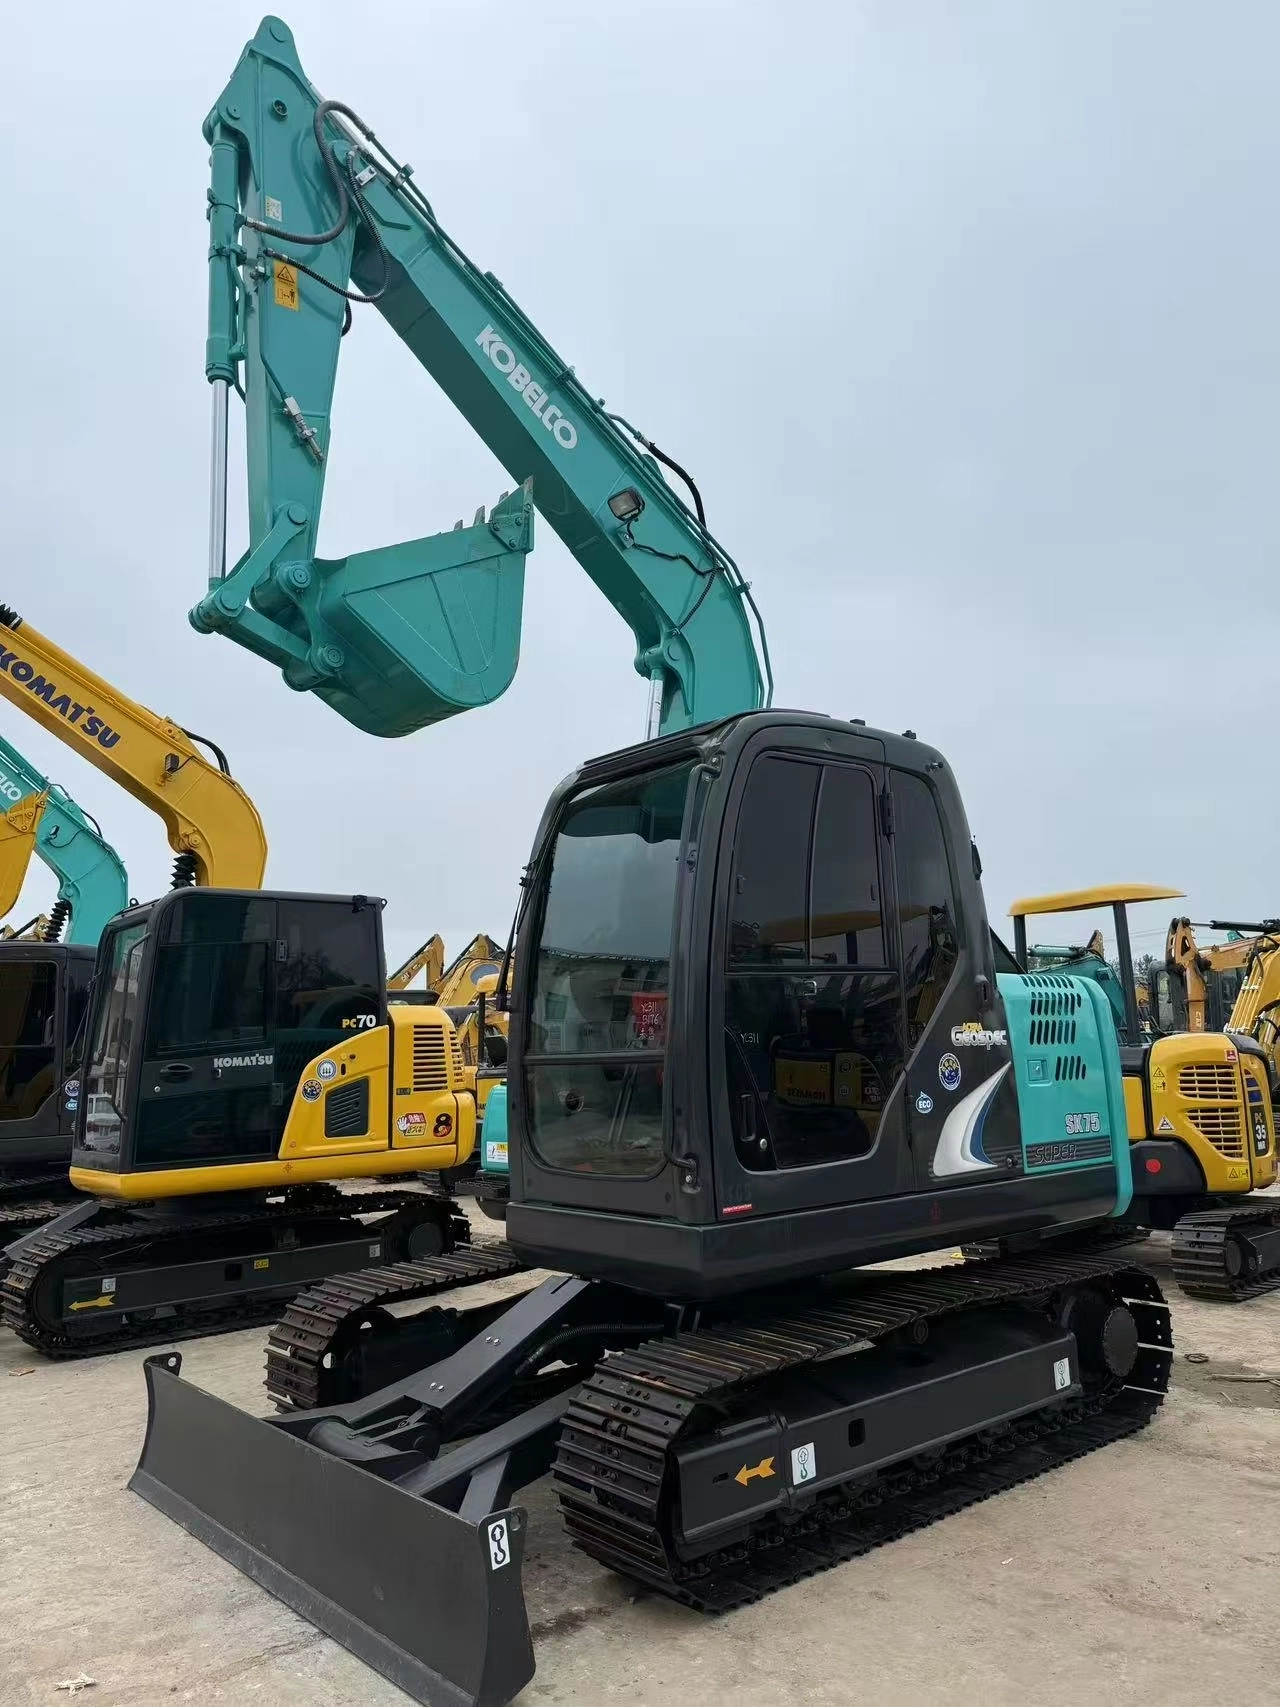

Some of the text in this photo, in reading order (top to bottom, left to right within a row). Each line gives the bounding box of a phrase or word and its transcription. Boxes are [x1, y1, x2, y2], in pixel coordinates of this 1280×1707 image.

[475, 323, 578, 450] KOBELCO
[0, 643, 121, 749] KOMATSU
[342, 1014, 377, 1029] PC70
[951, 1025, 1008, 1050] Geospec
[213, 1053, 274, 1068] KOMATSU
[918, 1100, 932, 1109] ECO
[1065, 1112, 1100, 1134] SK75
[1255, 1124, 1267, 1140] 35
[1035, 1143, 1077, 1164] SUPER
